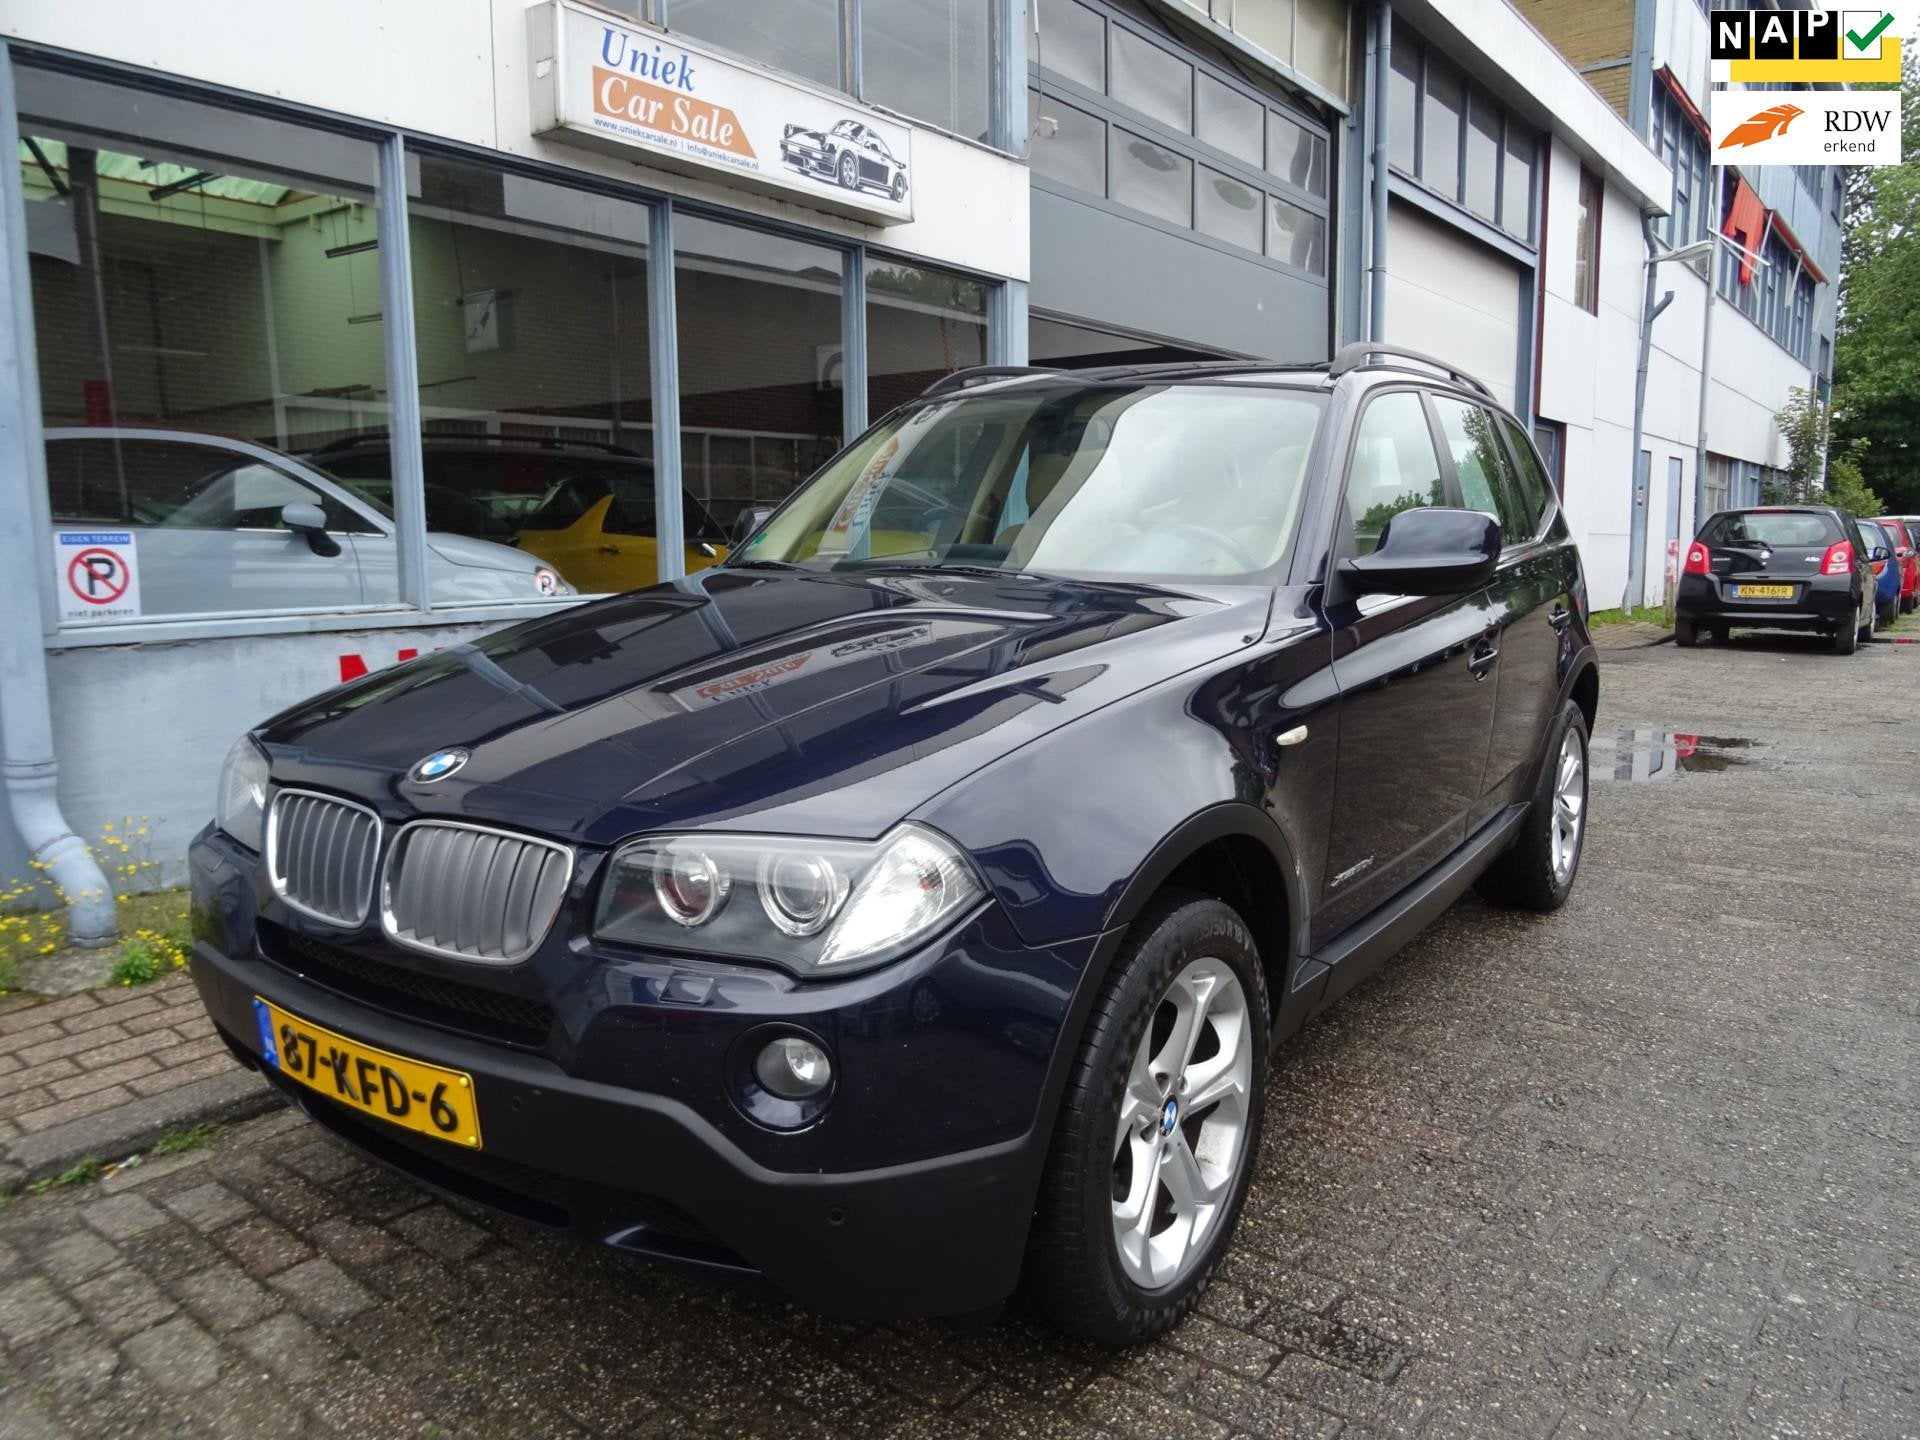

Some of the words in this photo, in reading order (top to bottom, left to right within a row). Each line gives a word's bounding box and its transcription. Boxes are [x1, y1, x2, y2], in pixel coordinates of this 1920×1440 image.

[602, 26, 696, 92] Uniek
[601, 77, 664, 124] Car
[671, 97, 733, 146] Sale
[593, 117, 678, 147] www.uniekcarsale.nl
[687, 143, 759, 171] info@uniekcarsale.nl
[62, 535, 90, 543] EIGEN
[92, 535, 129, 543] TERREIN
[91, 608, 135, 617] parkeren
[280, 1024, 459, 1133] 87-KFD-6
